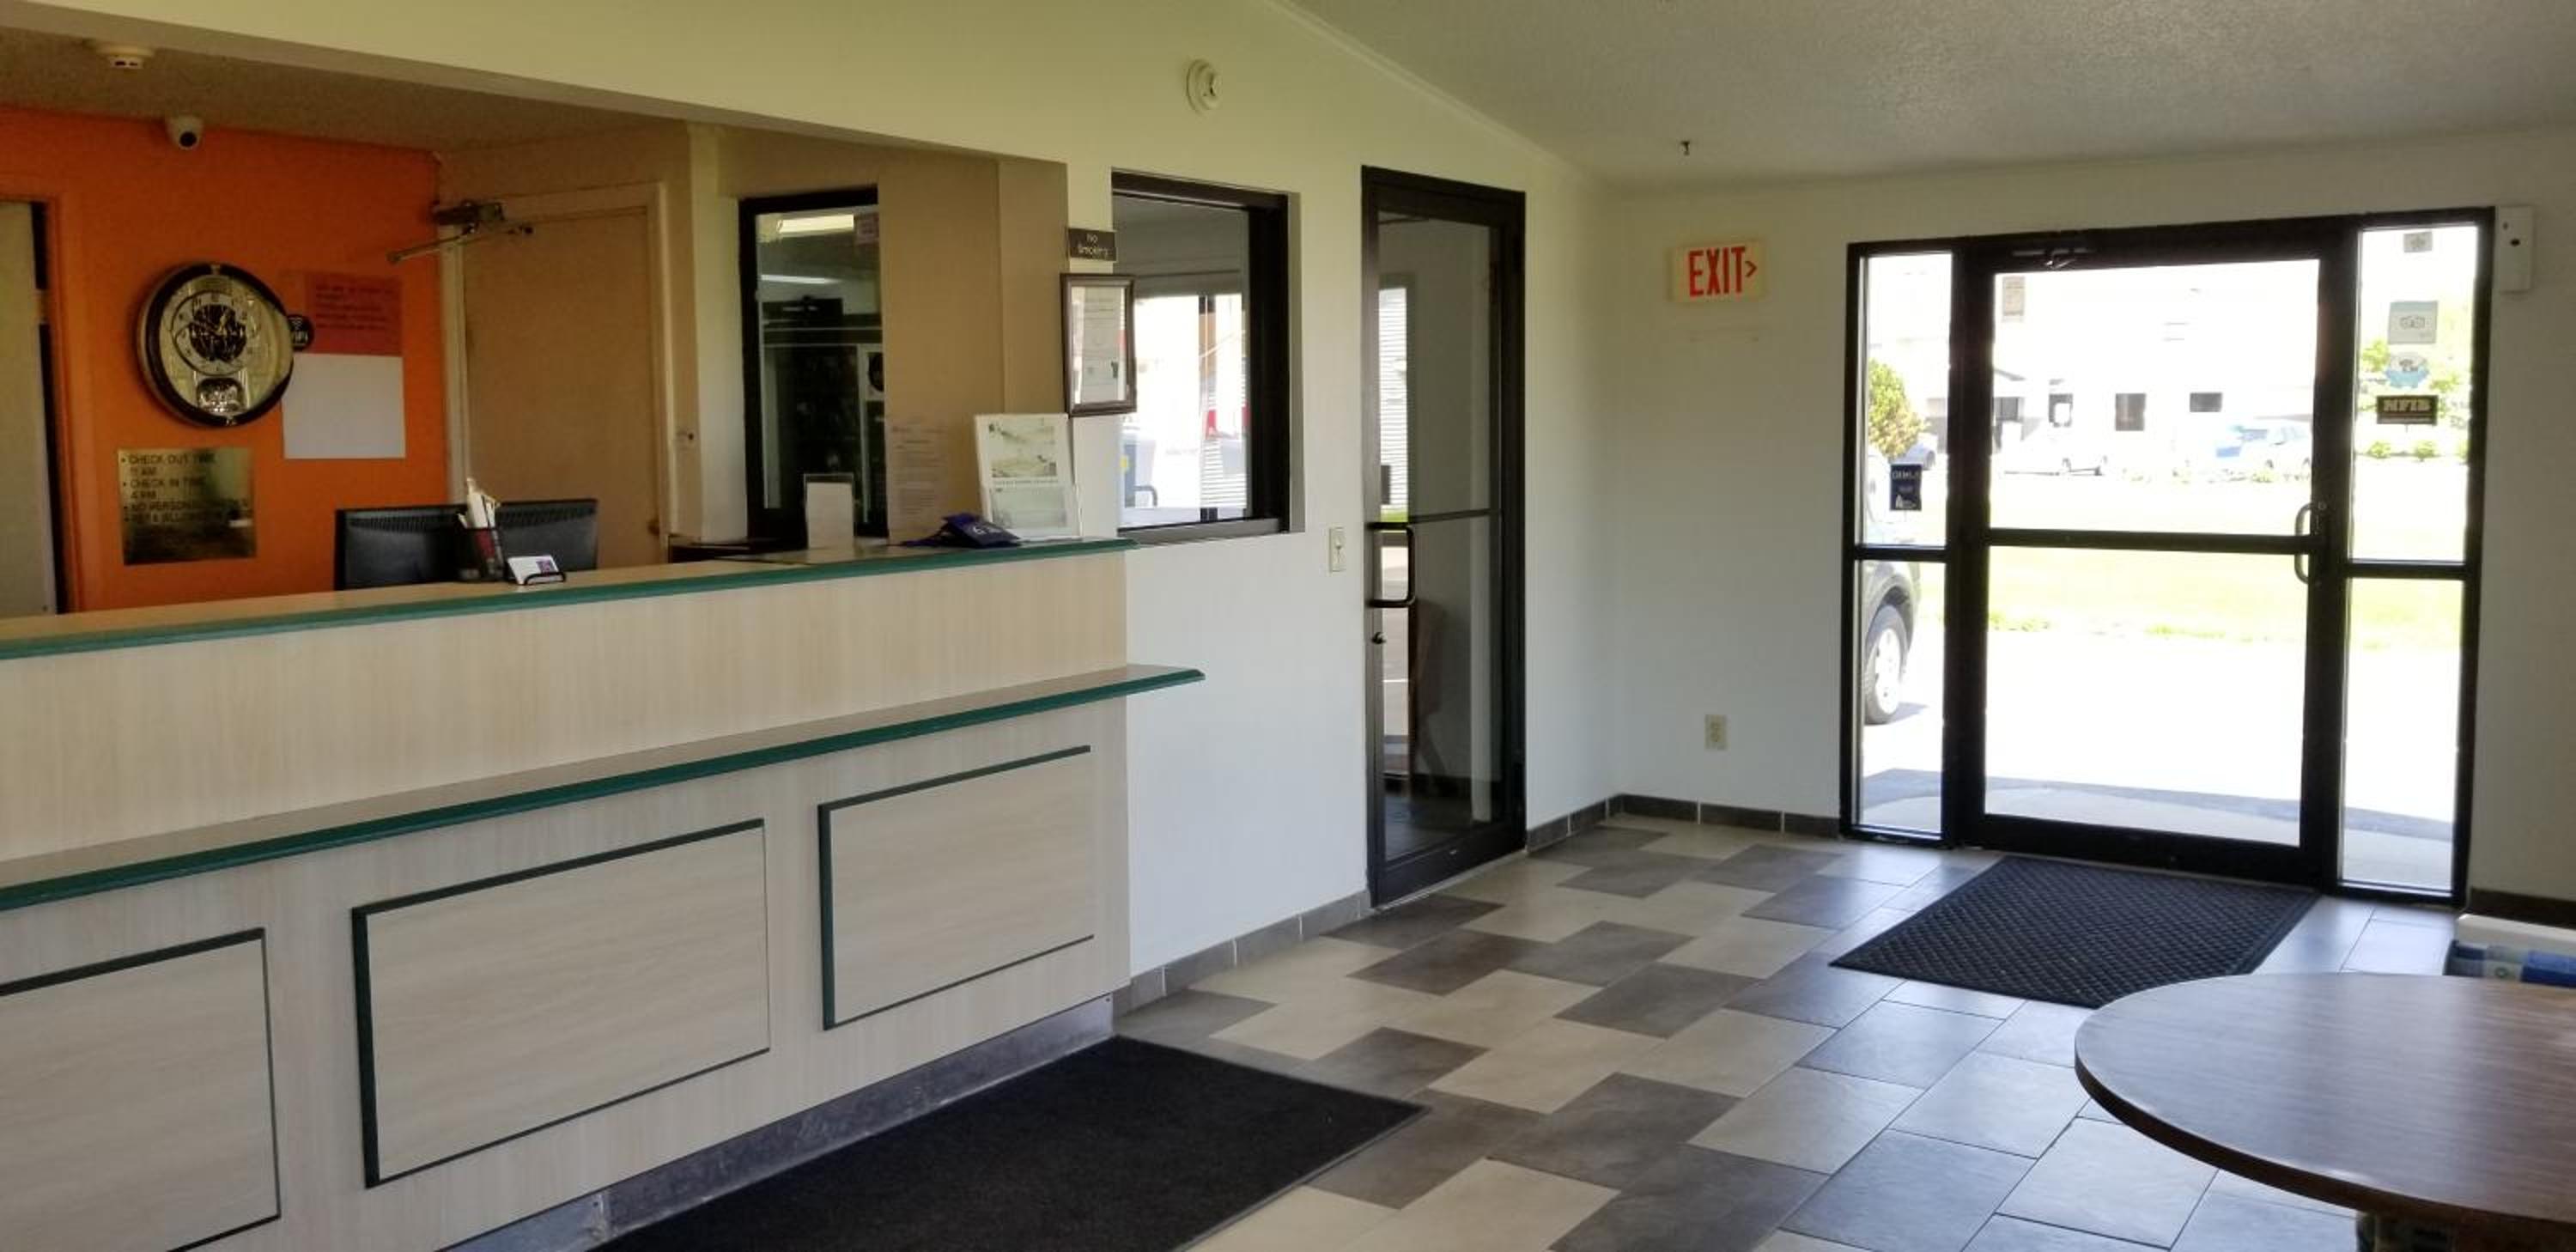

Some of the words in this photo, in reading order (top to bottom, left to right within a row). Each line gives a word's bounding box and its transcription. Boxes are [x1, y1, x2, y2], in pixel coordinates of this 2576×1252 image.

[1689, 246, 1746, 297] EXIT
[129, 453, 162, 465] CHECK
[167, 453, 189, 465] OUT
[131, 477, 165, 489] CHECK
